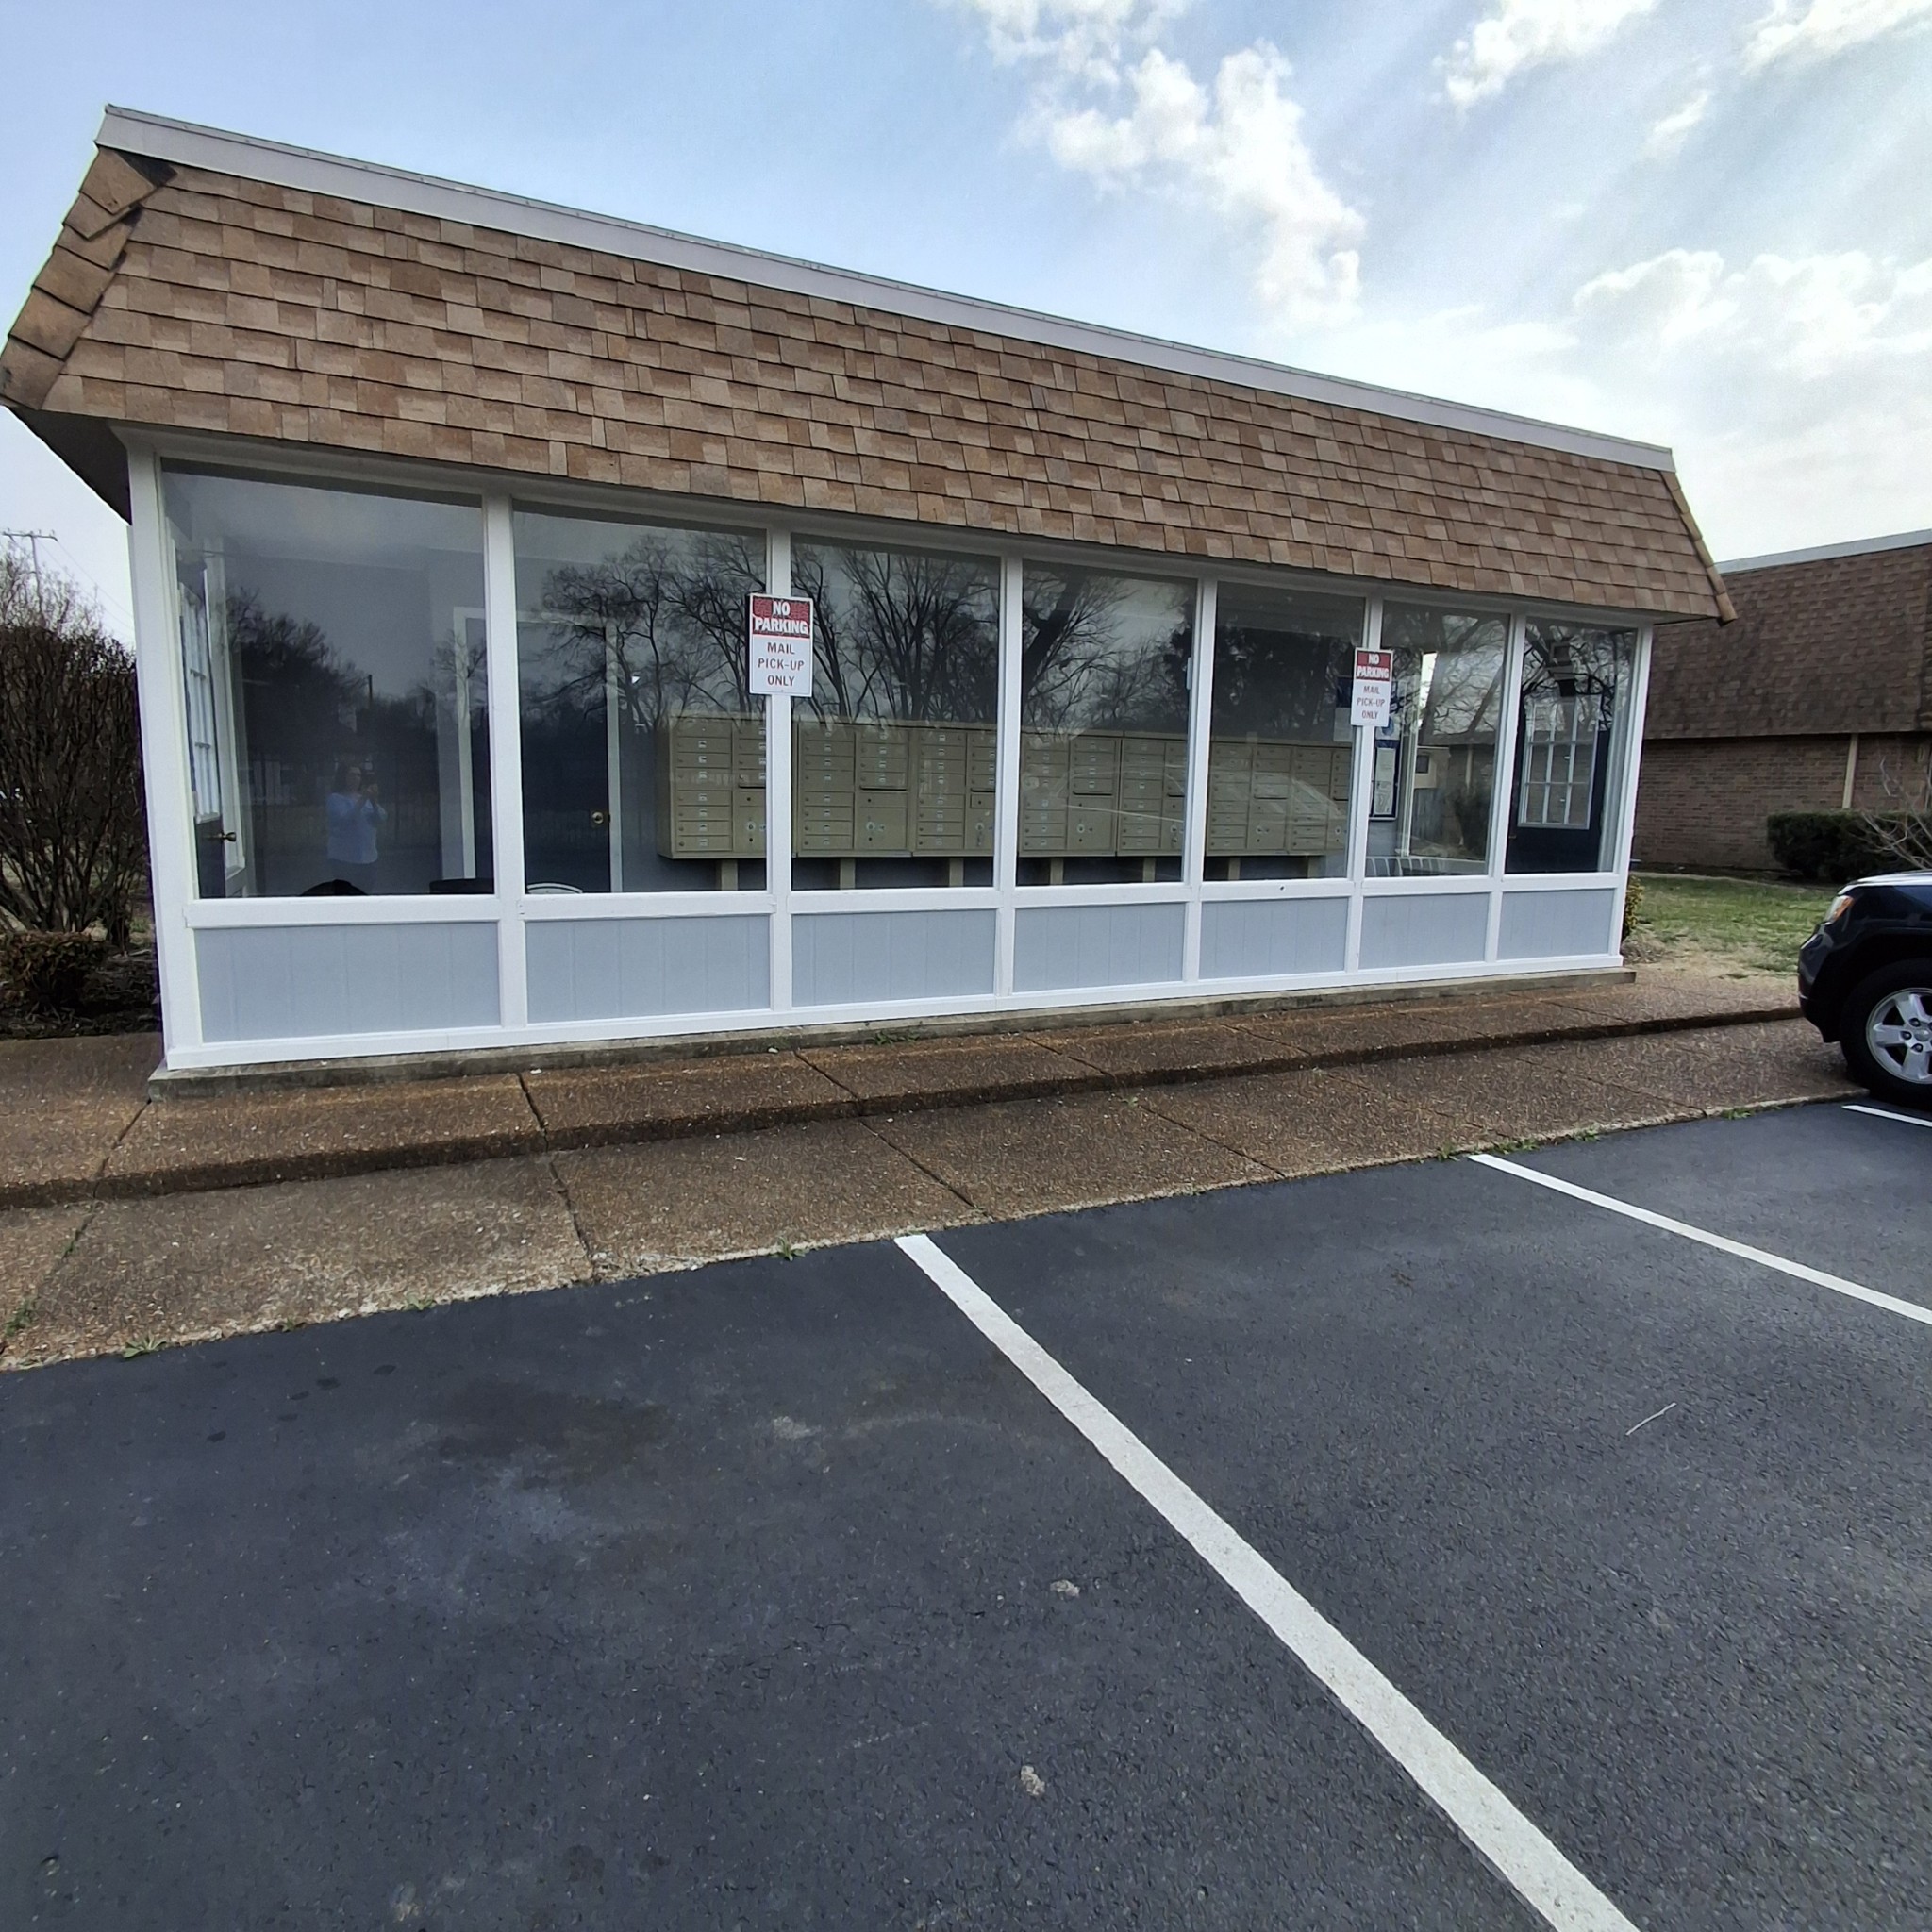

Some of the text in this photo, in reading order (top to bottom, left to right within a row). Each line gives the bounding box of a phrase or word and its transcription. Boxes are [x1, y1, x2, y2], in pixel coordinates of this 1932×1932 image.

[773, 601, 791, 616] NO
[755, 618, 808, 635] PARKING
[767, 642, 795, 654] MAIL
[1368, 653, 1380, 664] NO
[758, 658, 804, 671] PICK-UP
[1357, 666, 1389, 678] PARKING
[767, 675, 794, 686] ONLY
[1363, 685, 1380, 694] MAIL
[1357, 698, 1385, 707] PICK-UP
[1361, 710, 1378, 719] ONLY
